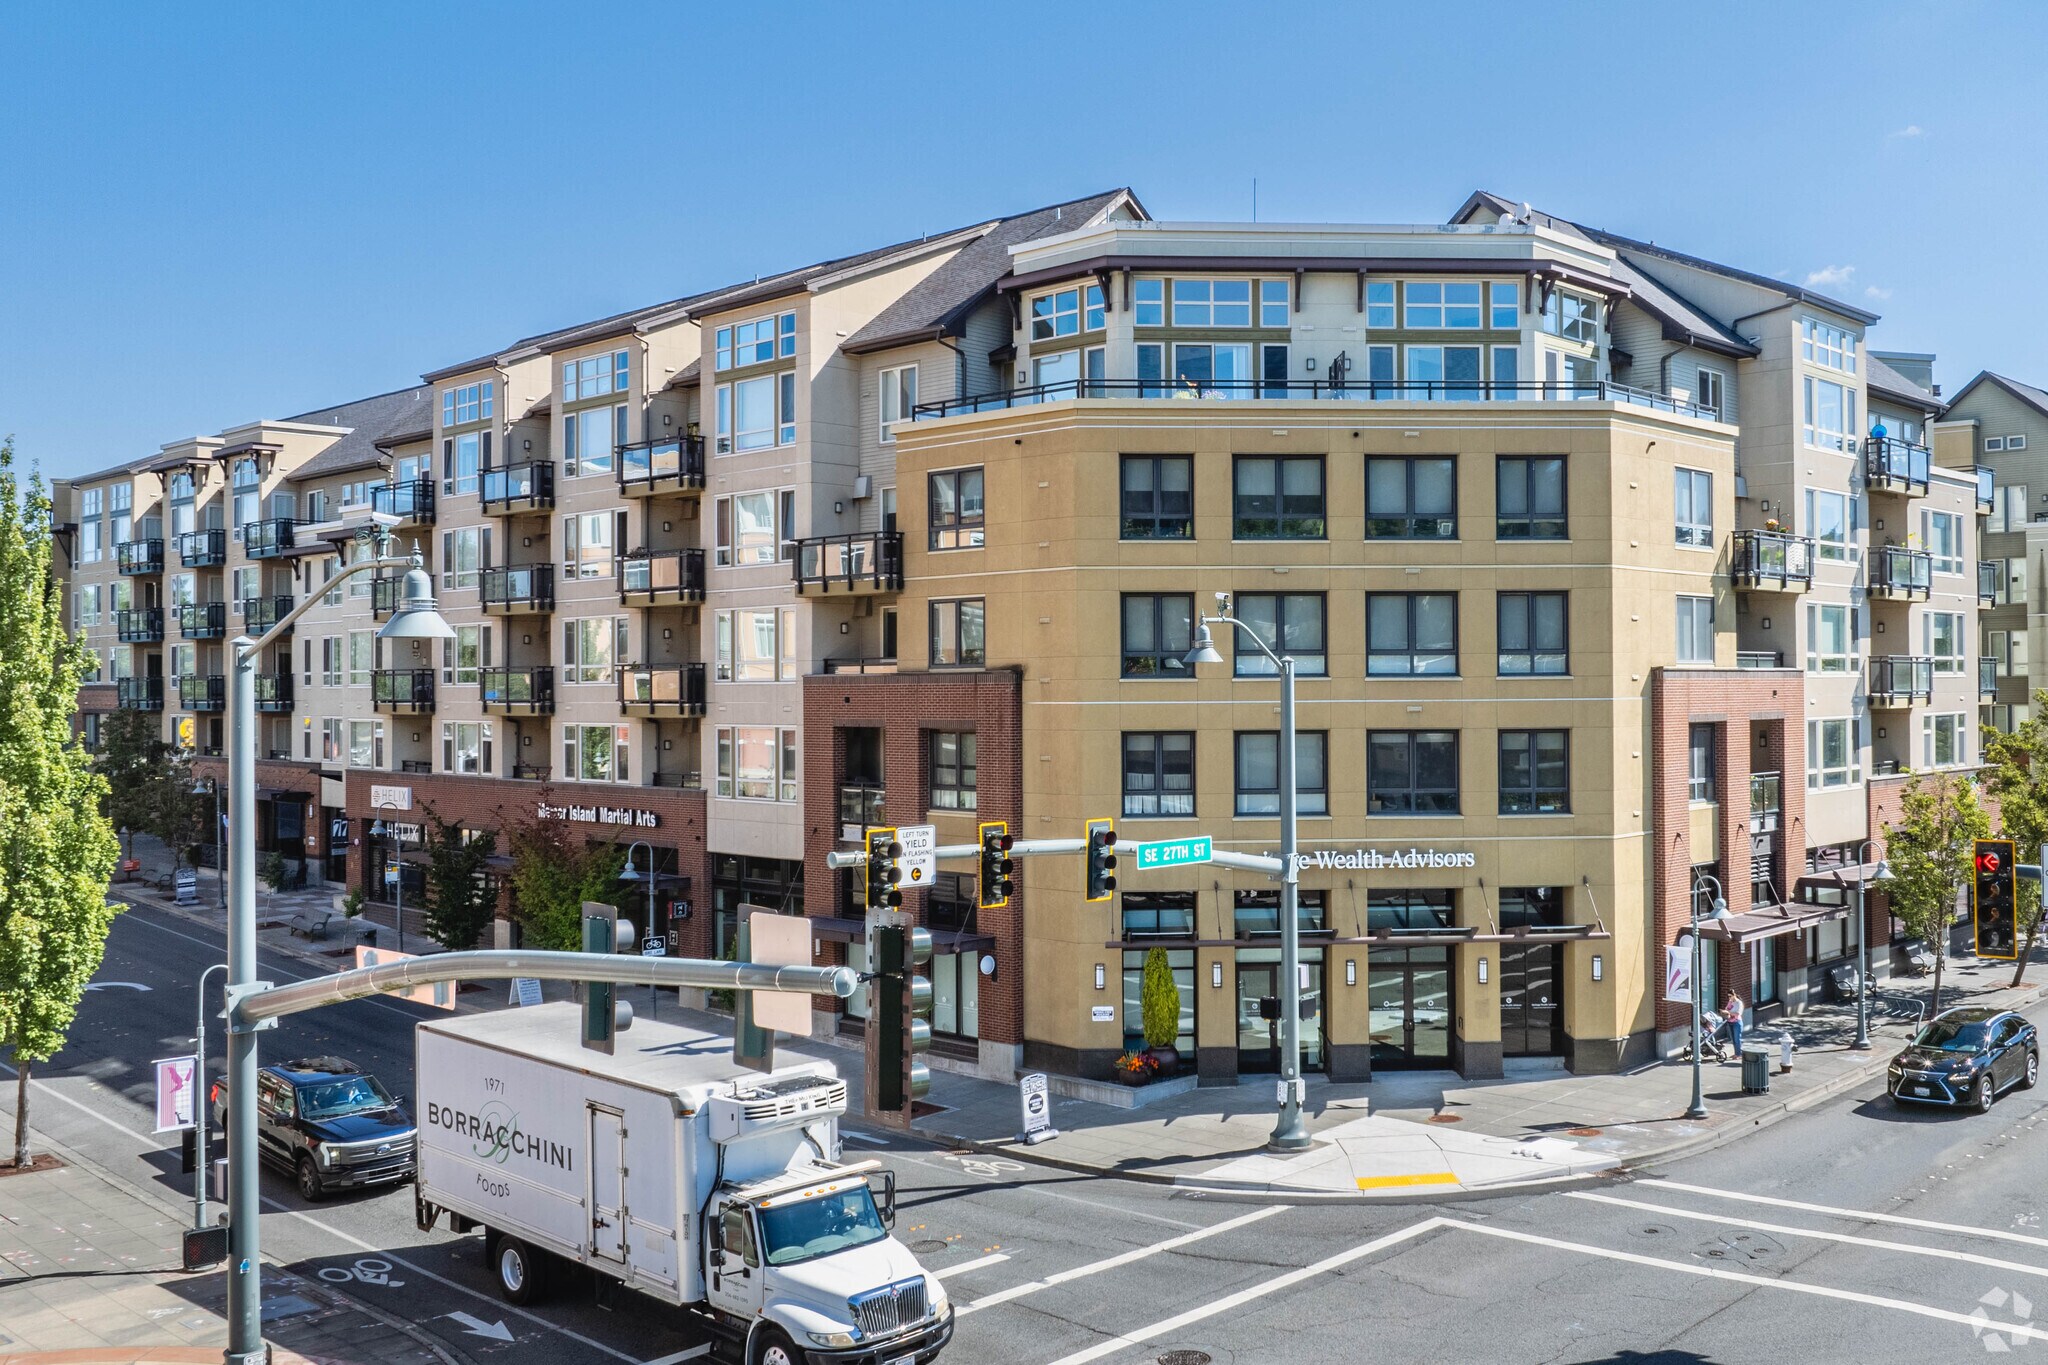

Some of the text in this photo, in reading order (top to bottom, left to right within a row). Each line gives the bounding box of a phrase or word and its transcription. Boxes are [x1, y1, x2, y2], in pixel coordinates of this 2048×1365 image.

[381, 788, 407, 803] HELIX
[569, 804, 596, 823] Island
[599, 806, 632, 826] Martial
[635, 809, 656, 828] Arts
[387, 821, 419, 843] HELIX
[905, 839, 927, 848] YIELD
[908, 849, 932, 857] FLASHING
[1144, 842, 1206, 863] SE 27TH ST
[906, 858, 926, 866] YELLOW
[1314, 849, 1385, 869] Wealth
[1388, 848, 1475, 868] Advisors
[484, 1077, 505, 1095] 1971
[428, 1101, 573, 1171] BORRACCHINI
[476, 1172, 510, 1198] FOODS
